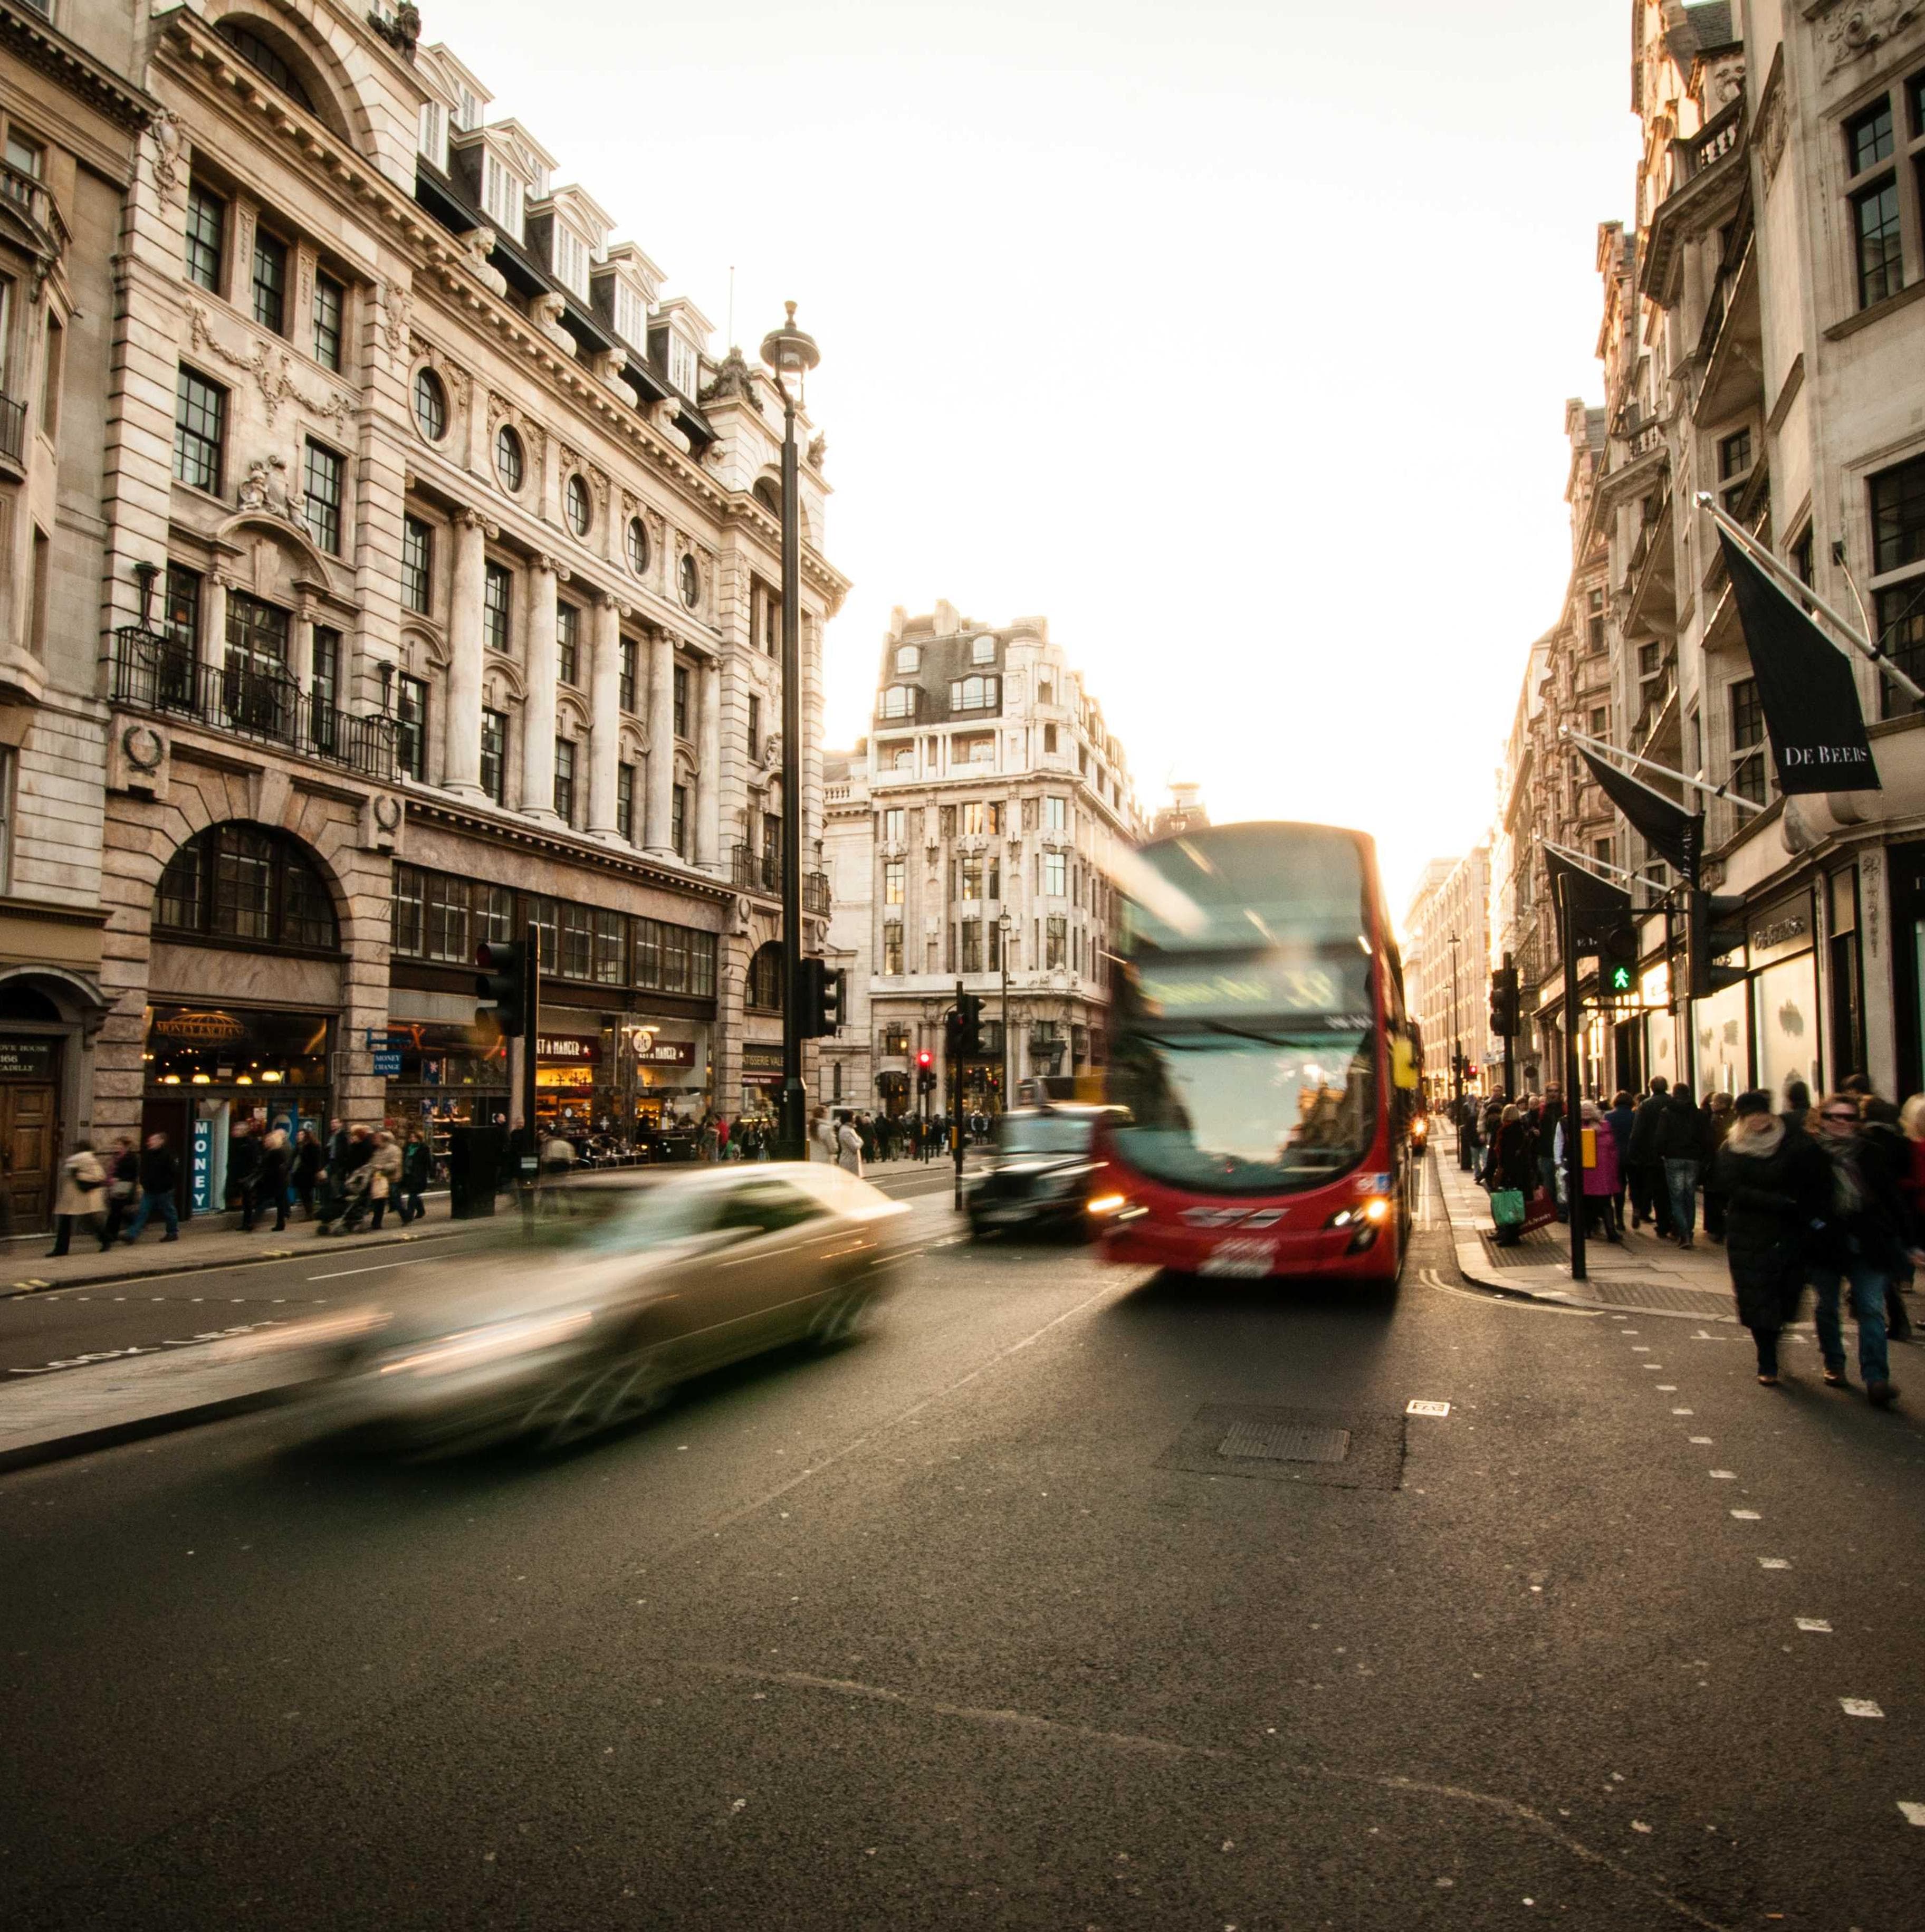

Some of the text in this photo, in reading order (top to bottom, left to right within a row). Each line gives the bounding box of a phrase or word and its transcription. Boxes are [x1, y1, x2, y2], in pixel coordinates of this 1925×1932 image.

[1785, 745, 1867, 766] DE BEERS
[546, 1040, 552, 1055] A
[553, 1040, 580, 1056] MANGER
[655, 1047, 676, 1060] MANGER
[194, 1122, 207, 1206] MONEY
